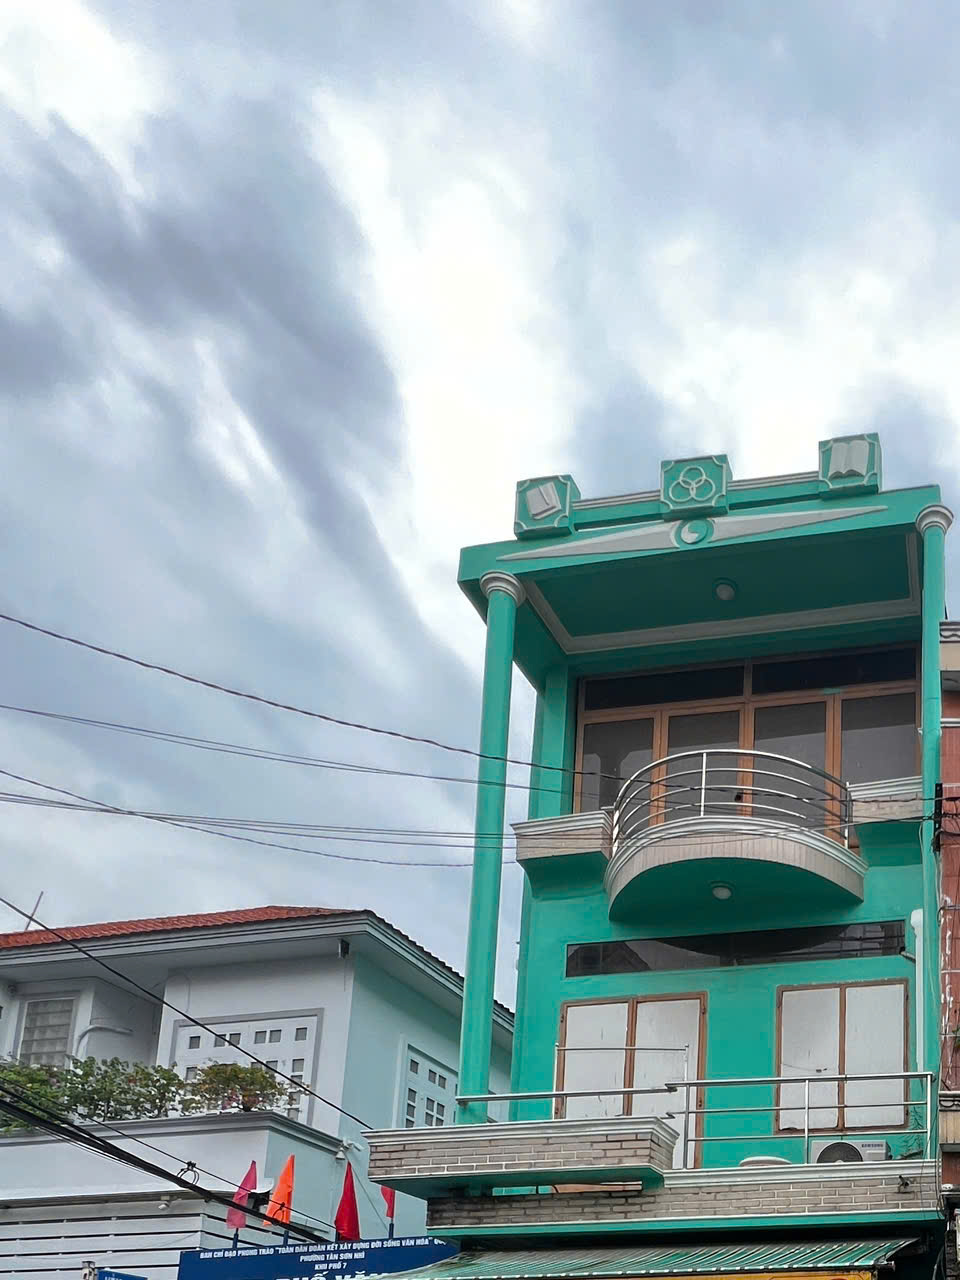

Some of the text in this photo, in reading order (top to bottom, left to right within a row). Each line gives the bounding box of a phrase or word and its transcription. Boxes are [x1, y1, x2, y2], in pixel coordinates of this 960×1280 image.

[200, 1251, 212, 1259] BAN
[237, 1249, 258, 1257] PHONG
[326, 1252, 338, 1260] TÂN
[339, 1252, 353, 1260] SƠN
[328, 1261, 342, 1270] PHỐ
[342, 1262, 348, 1270] 7
